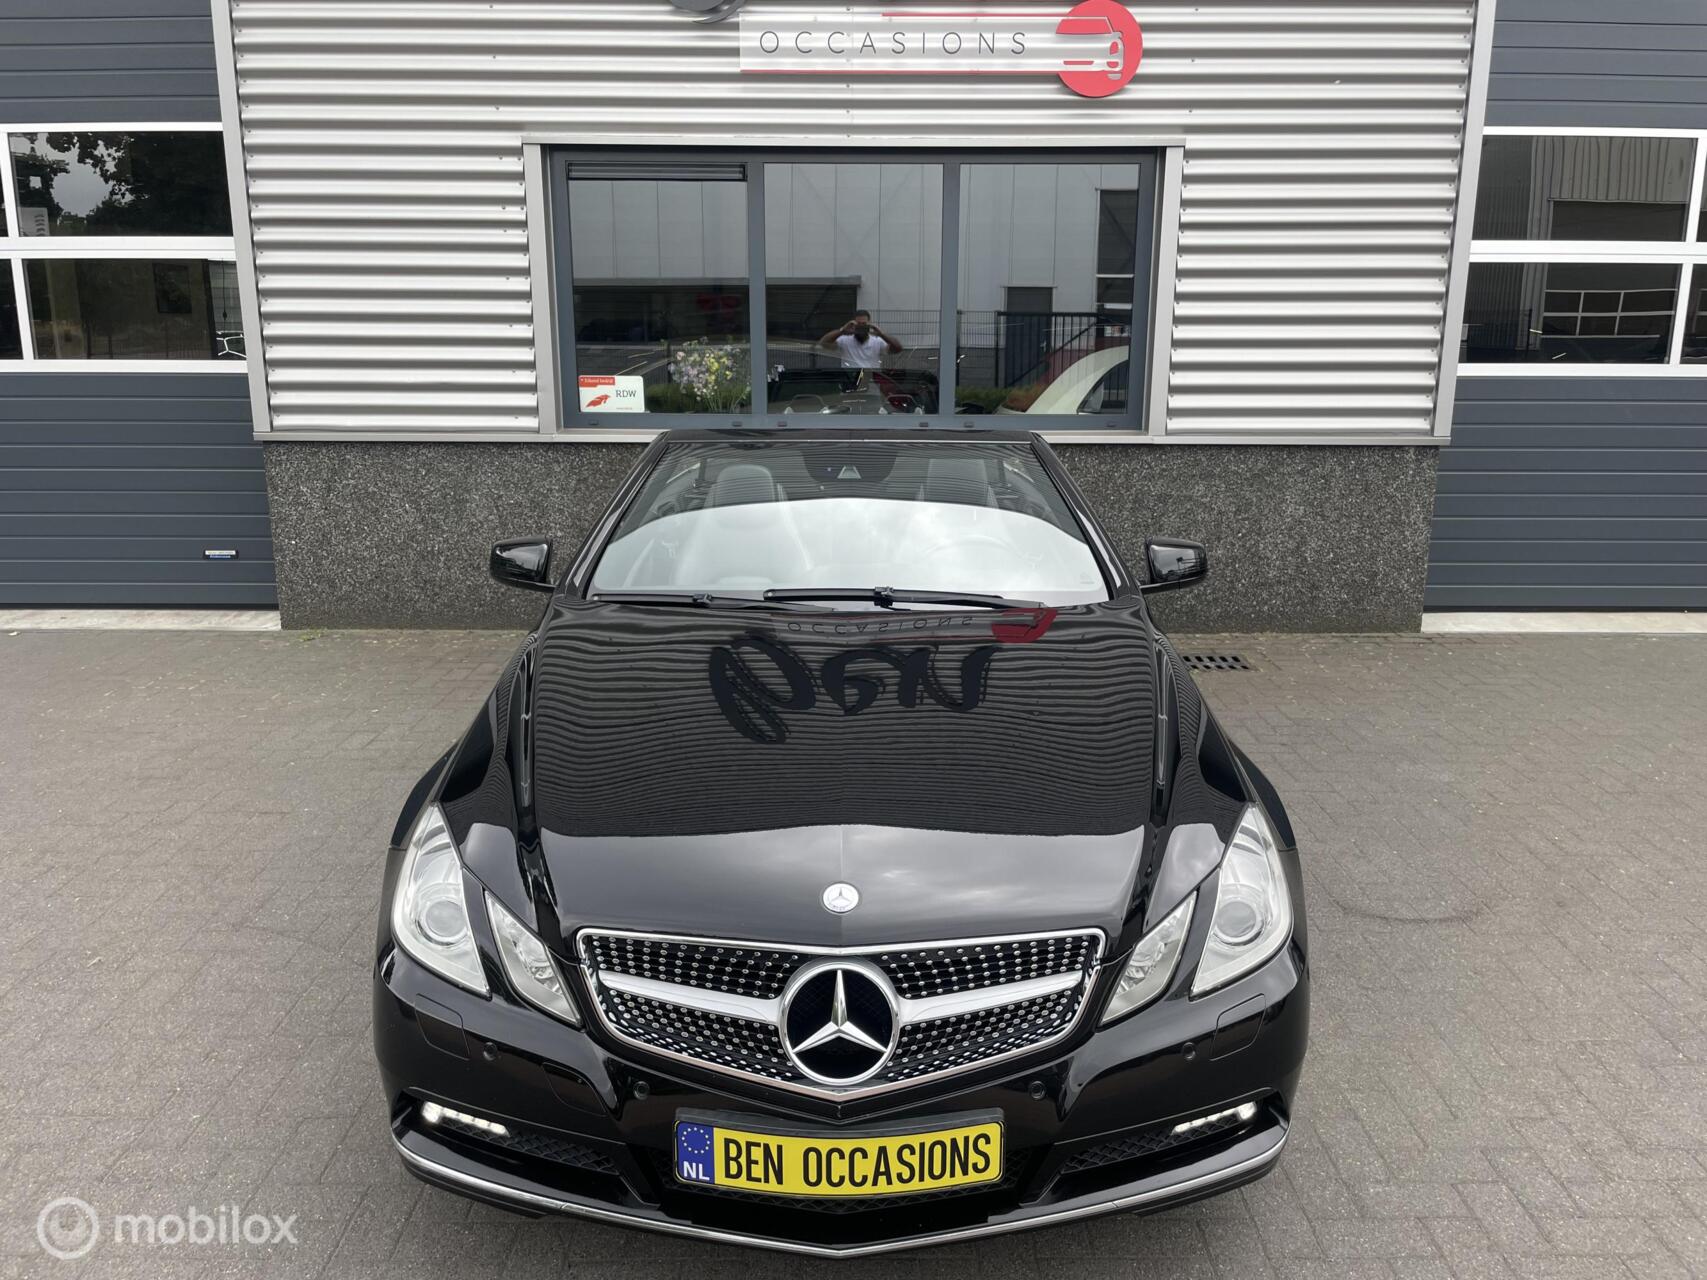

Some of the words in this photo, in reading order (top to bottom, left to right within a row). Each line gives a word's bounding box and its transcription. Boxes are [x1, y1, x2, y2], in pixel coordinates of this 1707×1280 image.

[759, 30, 1027, 55] OCCASIONS
[615, 389, 637, 398] RDW
[682, 1160, 711, 1181] NL
[723, 1137, 784, 1185] BEN
[802, 1133, 991, 1188] OCCASIONS
